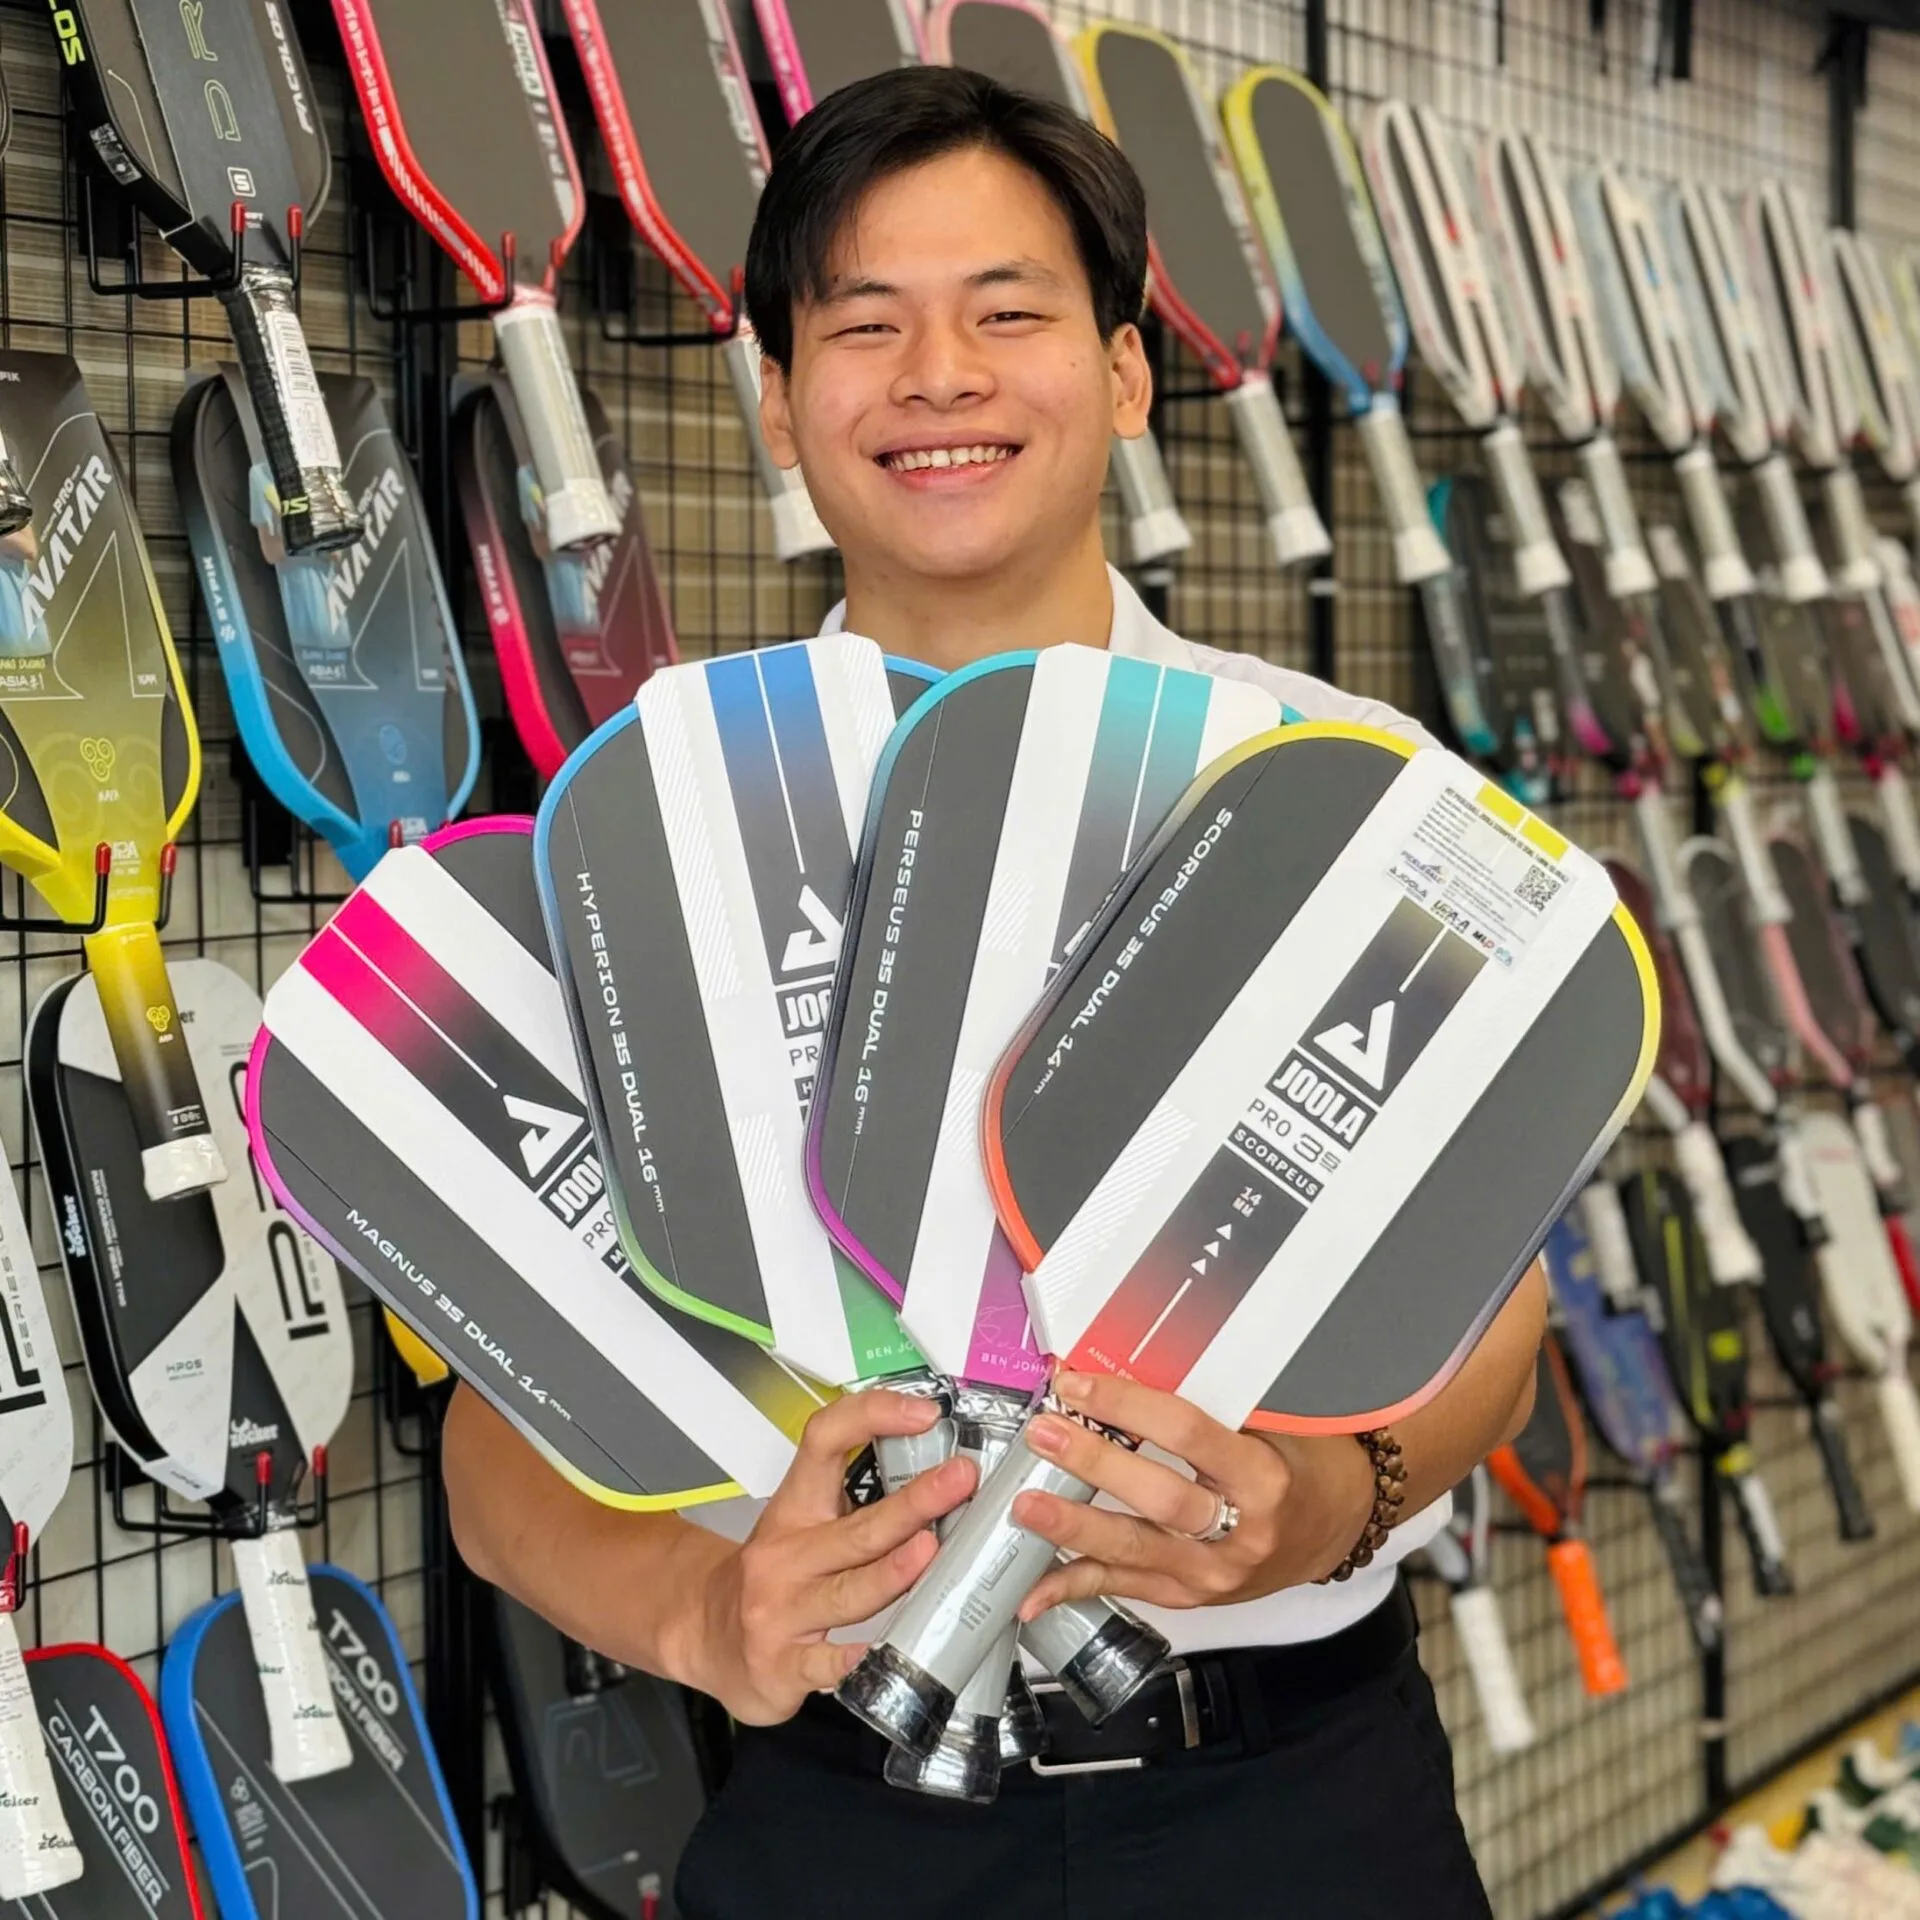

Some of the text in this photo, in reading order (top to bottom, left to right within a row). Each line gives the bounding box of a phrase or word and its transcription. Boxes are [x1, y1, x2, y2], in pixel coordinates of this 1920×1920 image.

[49, 0, 85, 65] OS
[265, 1, 313, 135] FACOLOS
[53, 476, 75, 517] PRO
[21, 455, 112, 640] AVATAR
[327, 467, 406, 636] AVATAR
[886, 809, 924, 944] PERSEUS
[1139, 807, 1233, 937] SCORPEUS
[576, 872, 623, 1027] HYPERION
[879, 949, 897, 984] 3S
[1117, 935, 1144, 968] 3S
[862, 989, 888, 1061] DUAL
[1071, 970, 1120, 1029] DUAL
[612, 1032, 633, 1067] 3S
[789, 1045, 819, 1067] PR
[620, 1070, 641, 1143] DUAL
[1247, 1098, 1292, 1138] PRO
[1273, 1058, 1367, 1145] JOOLA
[1233, 1128, 1318, 1197] SCORPEUS
[1239, 1185, 1263, 1207] 14
[1232, 1196, 1255, 1218] MM
[345, 1207, 436, 1297] MAGNUS
[434, 1292, 464, 1324] 3S
[463, 1317, 516, 1378] DUAL
[866, 1340, 914, 1360] BEN JO
[981, 1353, 1048, 1374] BEN JOHN
[1087, 1347, 1116, 1373] ANNA
[329, 1608, 399, 1716] T700
[84, 1704, 160, 1834] T700
[357, 1705, 404, 1773] FIBER
[49, 1716, 163, 1907] CARBON FIBER
